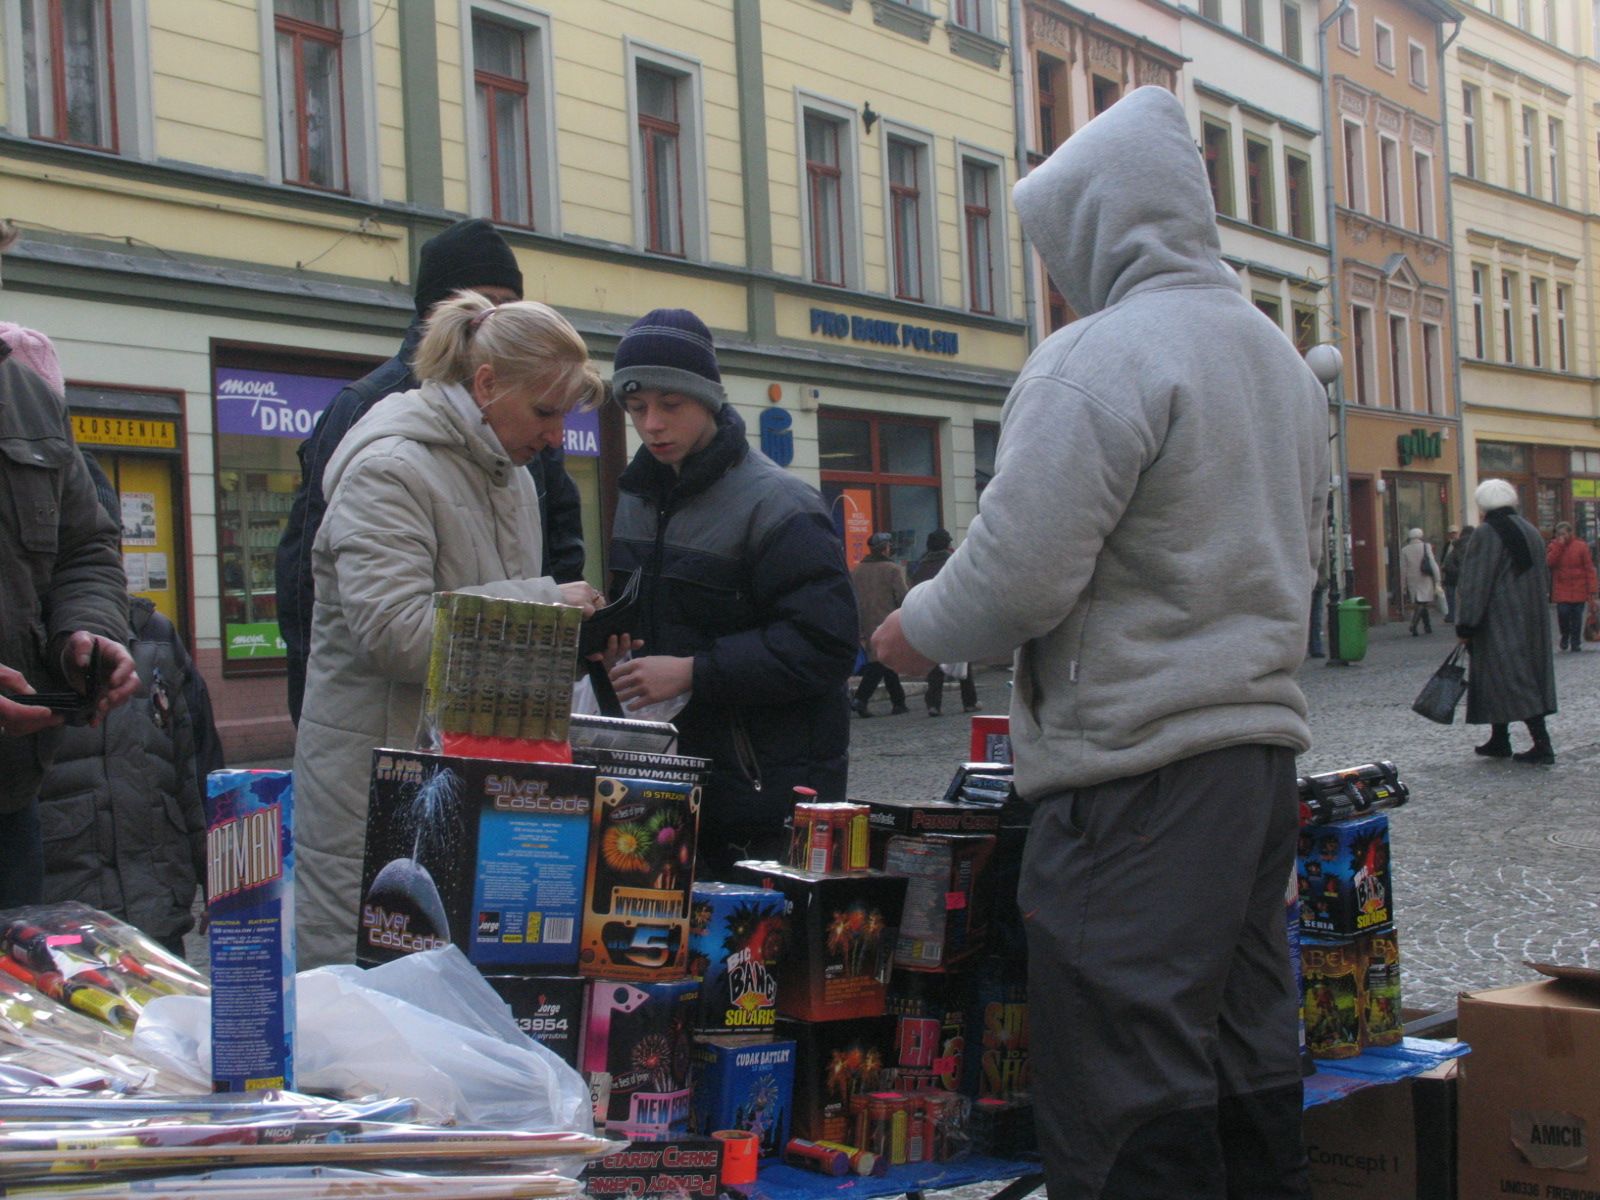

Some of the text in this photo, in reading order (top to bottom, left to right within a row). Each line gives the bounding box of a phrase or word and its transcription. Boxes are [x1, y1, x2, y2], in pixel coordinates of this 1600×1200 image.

[851, 315, 900, 346] BANK
[70, 419, 168, 438] ŁOSZENIA
[484, 774, 548, 796] Silver
[495, 793, 590, 815] Cascade
[363, 904, 410, 931] Silver
[1304, 920, 1334, 931] SERIA
[369, 928, 447, 953] Cascade
[727, 947, 751, 974] BIG
[725, 1008, 776, 1026] SOLARIS
[637, 1098, 670, 1124] NEW
